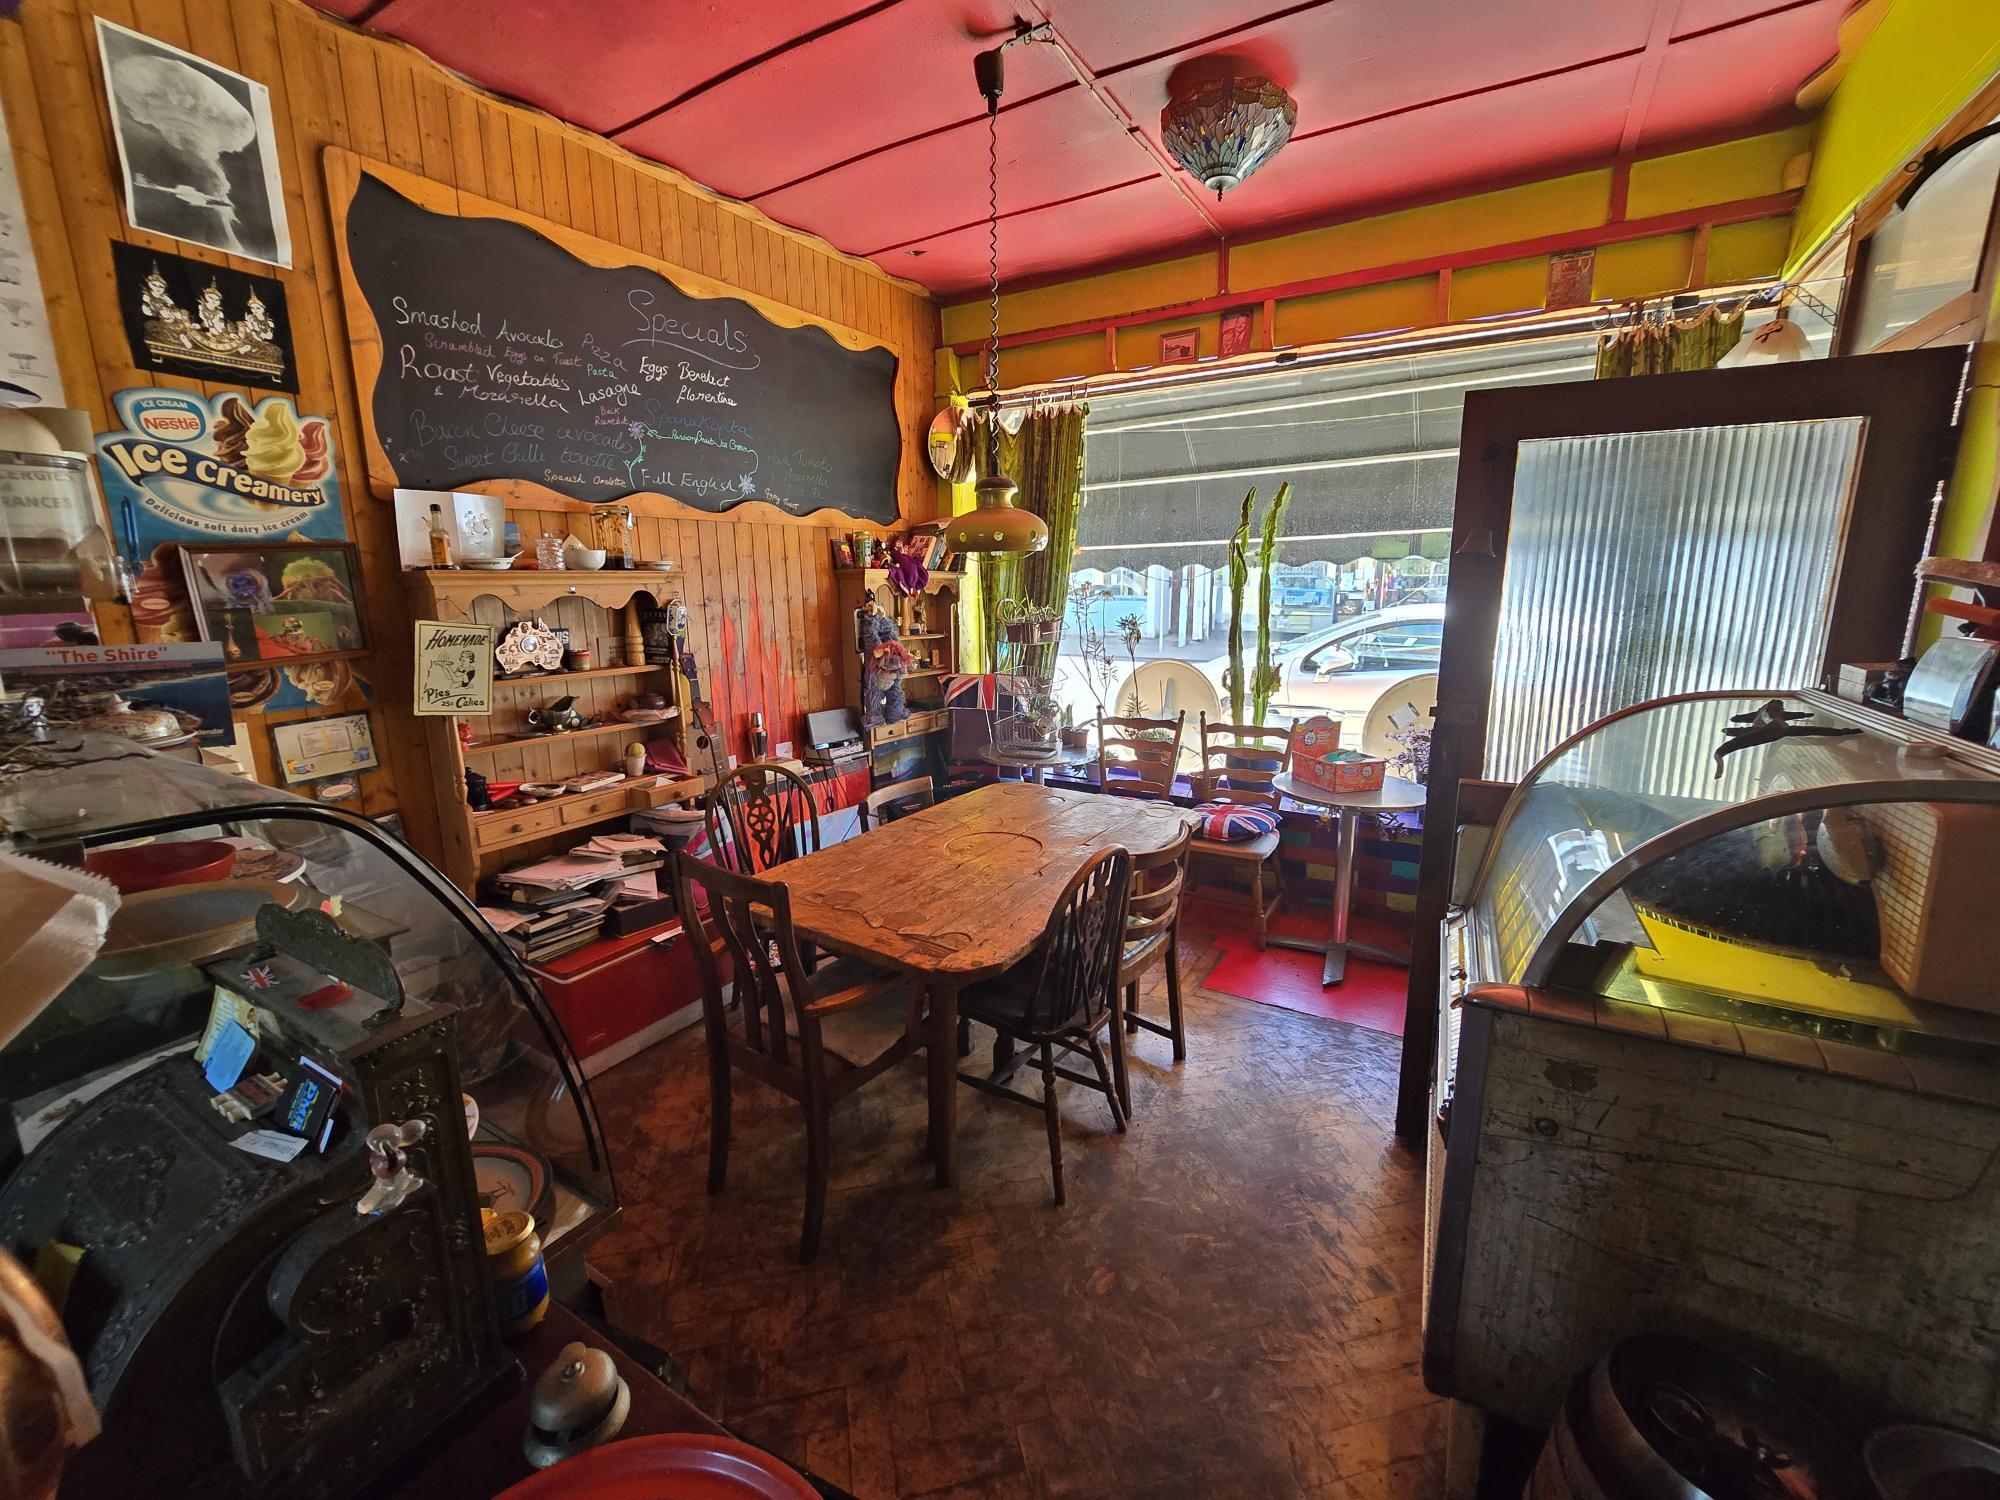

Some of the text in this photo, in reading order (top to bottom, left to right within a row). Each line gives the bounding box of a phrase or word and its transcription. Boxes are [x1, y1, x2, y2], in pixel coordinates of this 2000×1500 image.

[392, 296, 563, 349] Smashed Avocado
[627, 289, 749, 353] Specials
[424, 332, 582, 367] Scrambled Eggs on Toast
[582, 333, 627, 372] Pizza
[400, 344, 570, 391] Roast Vegetables
[587, 364, 618, 379] Pasta
[639, 356, 730, 387] Eggs Benedict
[140, 400, 188, 410] ICE CREAM
[578, 382, 641, 407] Lasagne
[483, 412, 545, 440] Cheese
[110, 443, 322, 505] Ice creamery
[543, 469, 586, 483] Spanish
[641, 468, 737, 496] Full English
[145, 498, 309, 535] Delicious soft dairy ice cream
[424, 629, 489, 650] HOMEMADE
[45, 646, 169, 663] "The Shire"
[423, 688, 451, 702] Pies
[456, 697, 485, 708] Cakes
